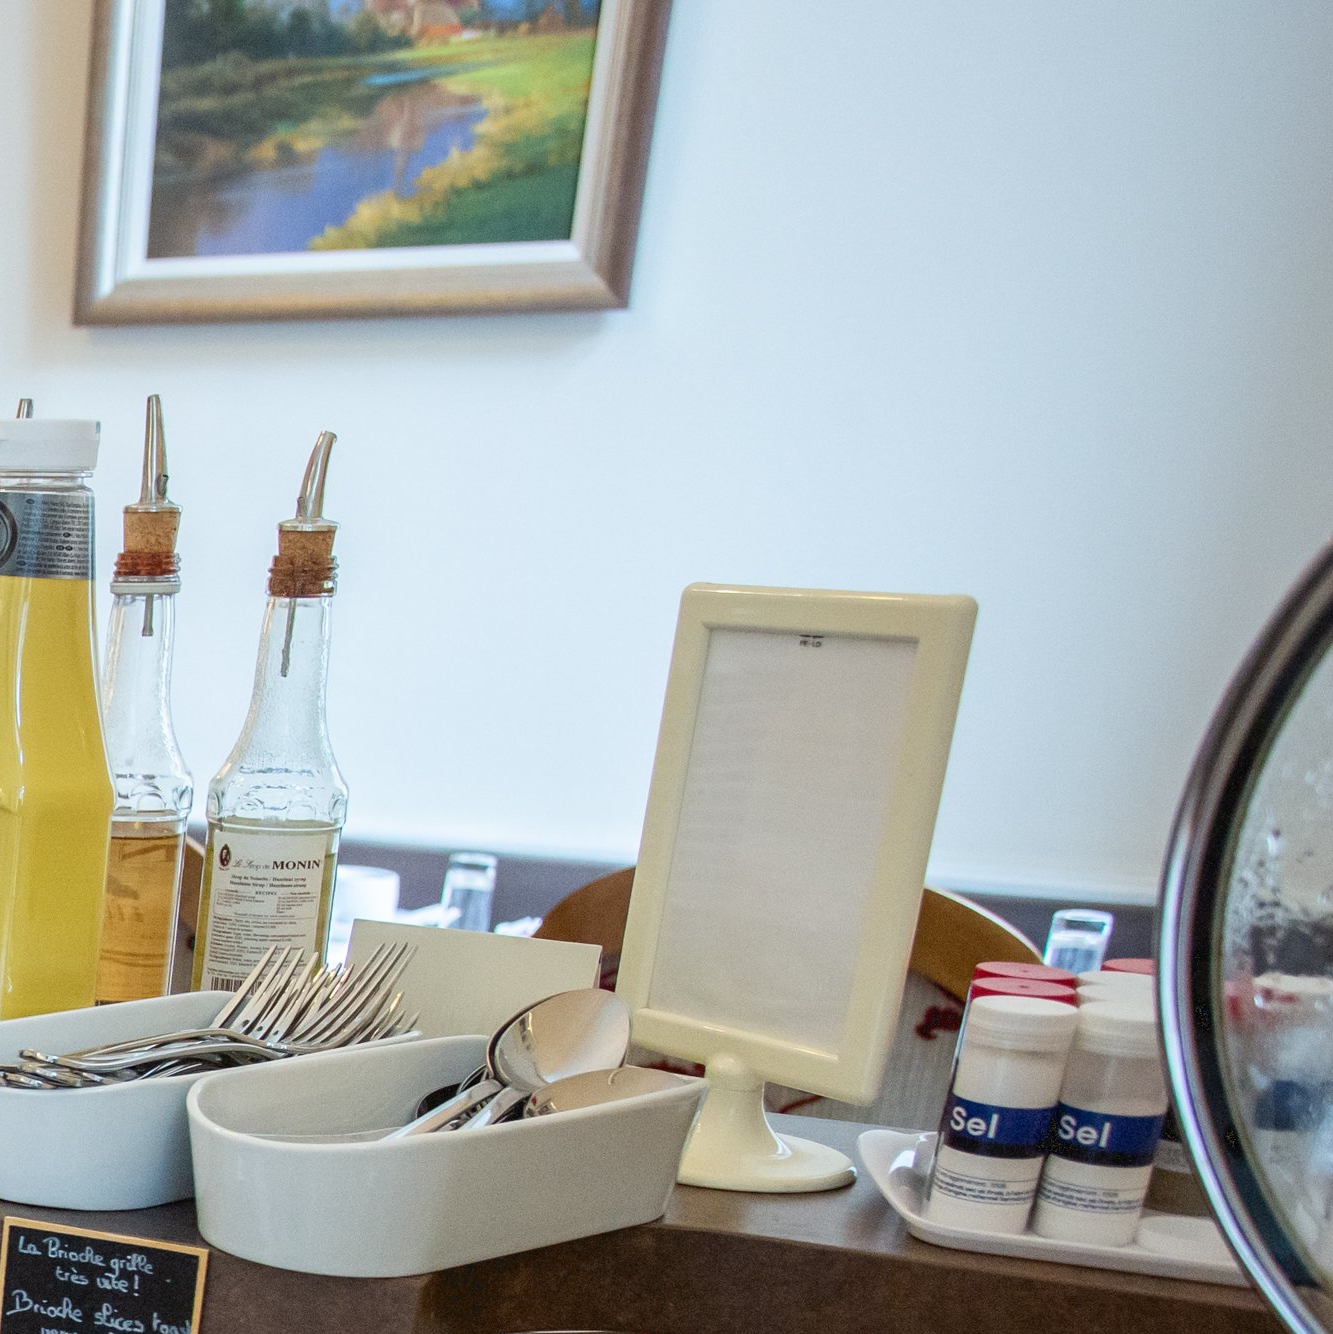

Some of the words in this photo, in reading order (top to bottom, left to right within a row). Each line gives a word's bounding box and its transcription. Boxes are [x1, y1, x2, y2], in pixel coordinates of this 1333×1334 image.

[272, 859, 321, 870] MONIN
[950, 1107, 999, 1139] Sel
[1058, 1115, 1111, 1148] Sel
[18, 1235, 41, 1255] La
[43, 1236, 106, 1267] Brioche
[110, 1253, 154, 1279] grille
[55, 1266, 89, 1286] très
[6, 1289, 83, 1323] Brioche
[94, 1302, 145, 1333] slices
